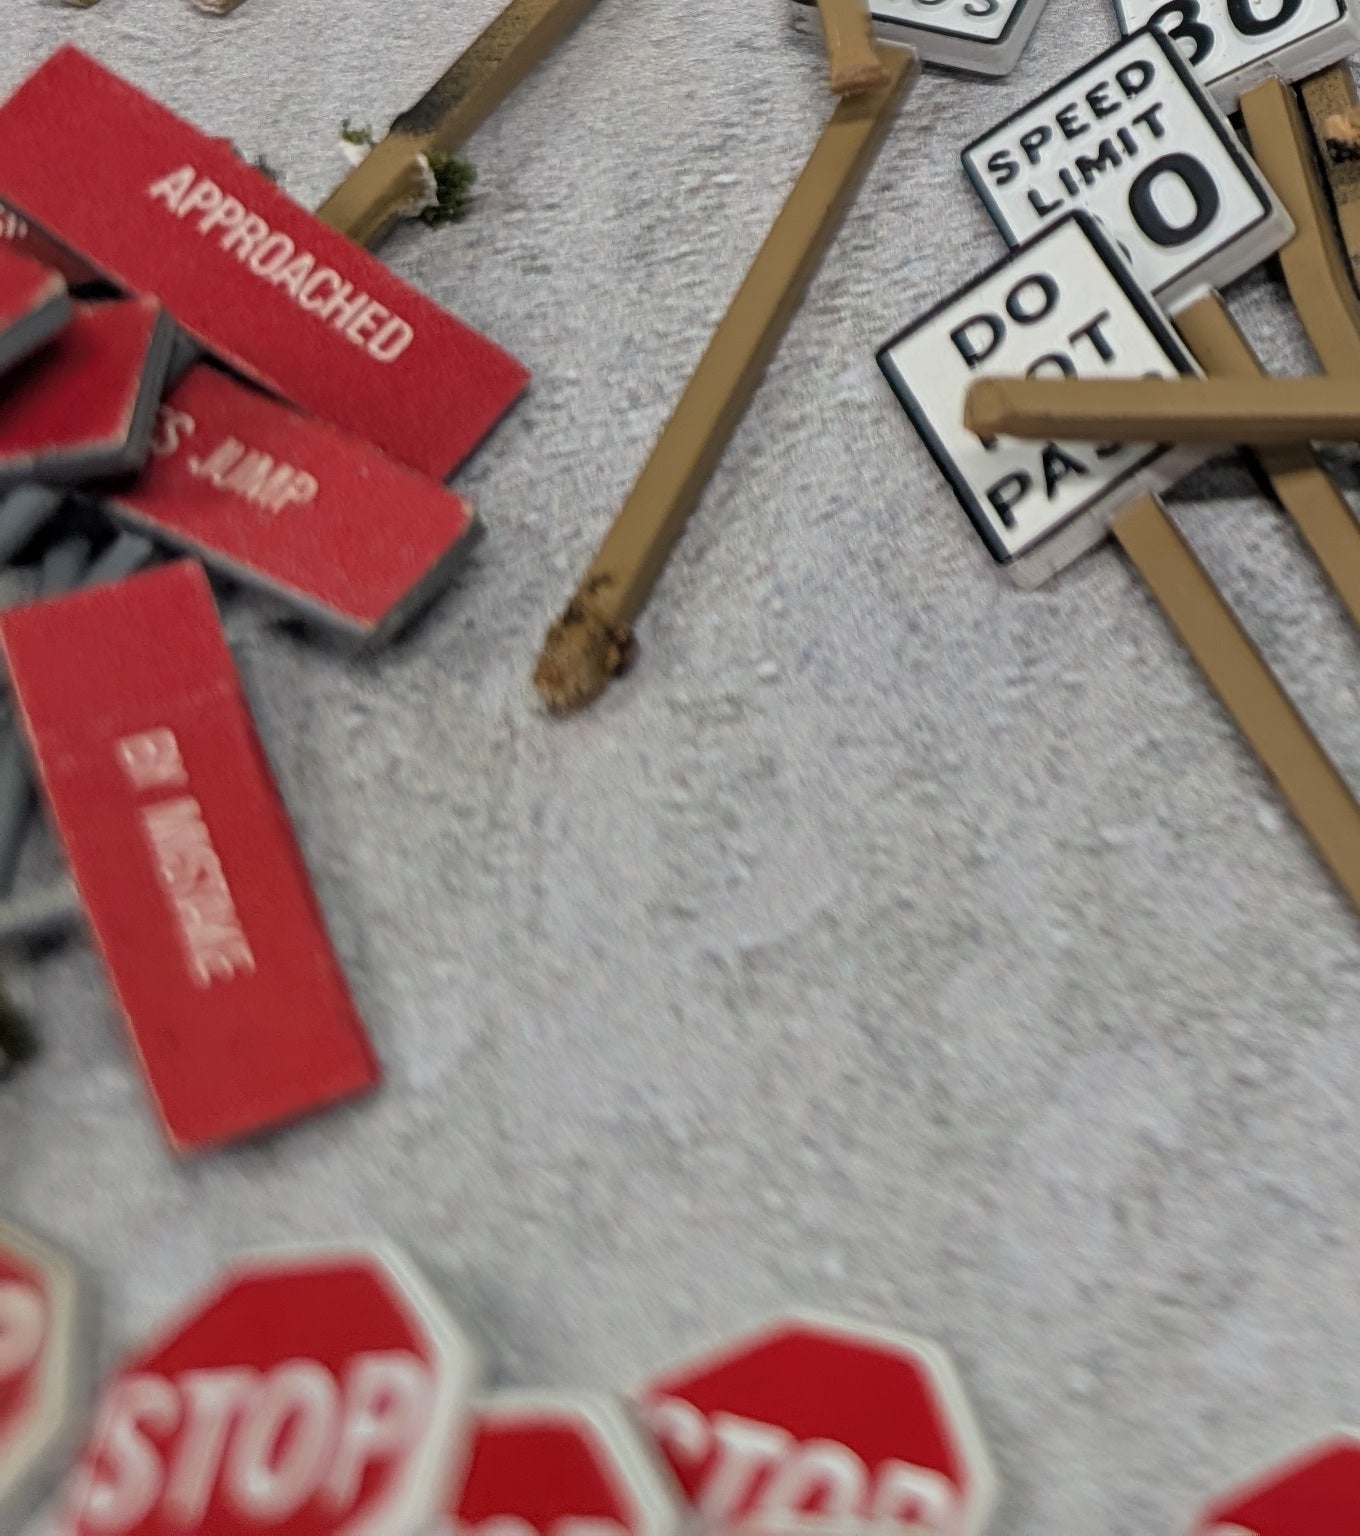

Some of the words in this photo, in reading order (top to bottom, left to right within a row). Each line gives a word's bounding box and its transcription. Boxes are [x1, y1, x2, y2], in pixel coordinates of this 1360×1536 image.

[987, 59, 1156, 187] SPEED
[1027, 102, 1170, 217] LIMIT
[149, 166, 414, 363] APPROACHED
[1092, 150, 1222, 266] 0
[951, 273, 1060, 368] DO
[80, 1349, 434, 1532] STOP
